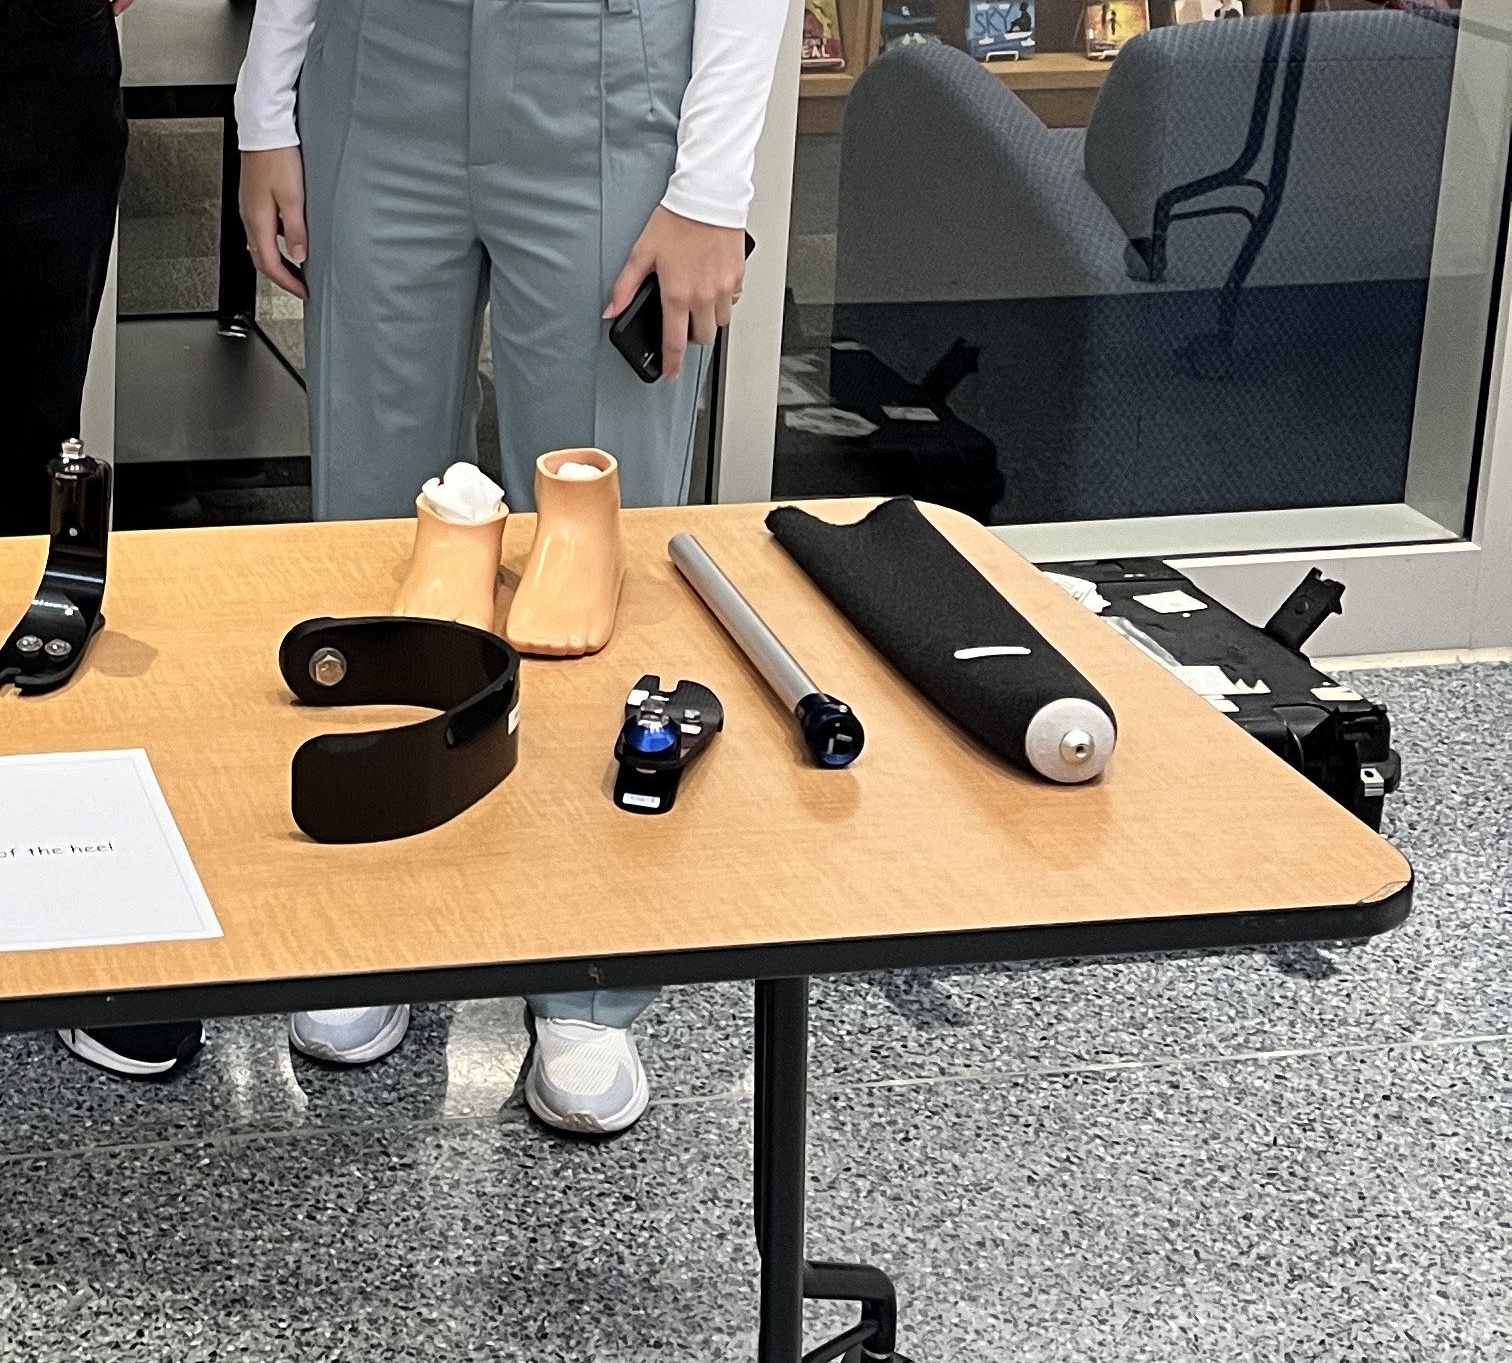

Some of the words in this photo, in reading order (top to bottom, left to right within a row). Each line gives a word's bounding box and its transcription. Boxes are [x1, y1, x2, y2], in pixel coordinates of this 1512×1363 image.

[975, 2, 1014, 35] SKY
[29, 846, 64, 856] the
[70, 842, 113, 854] heel
